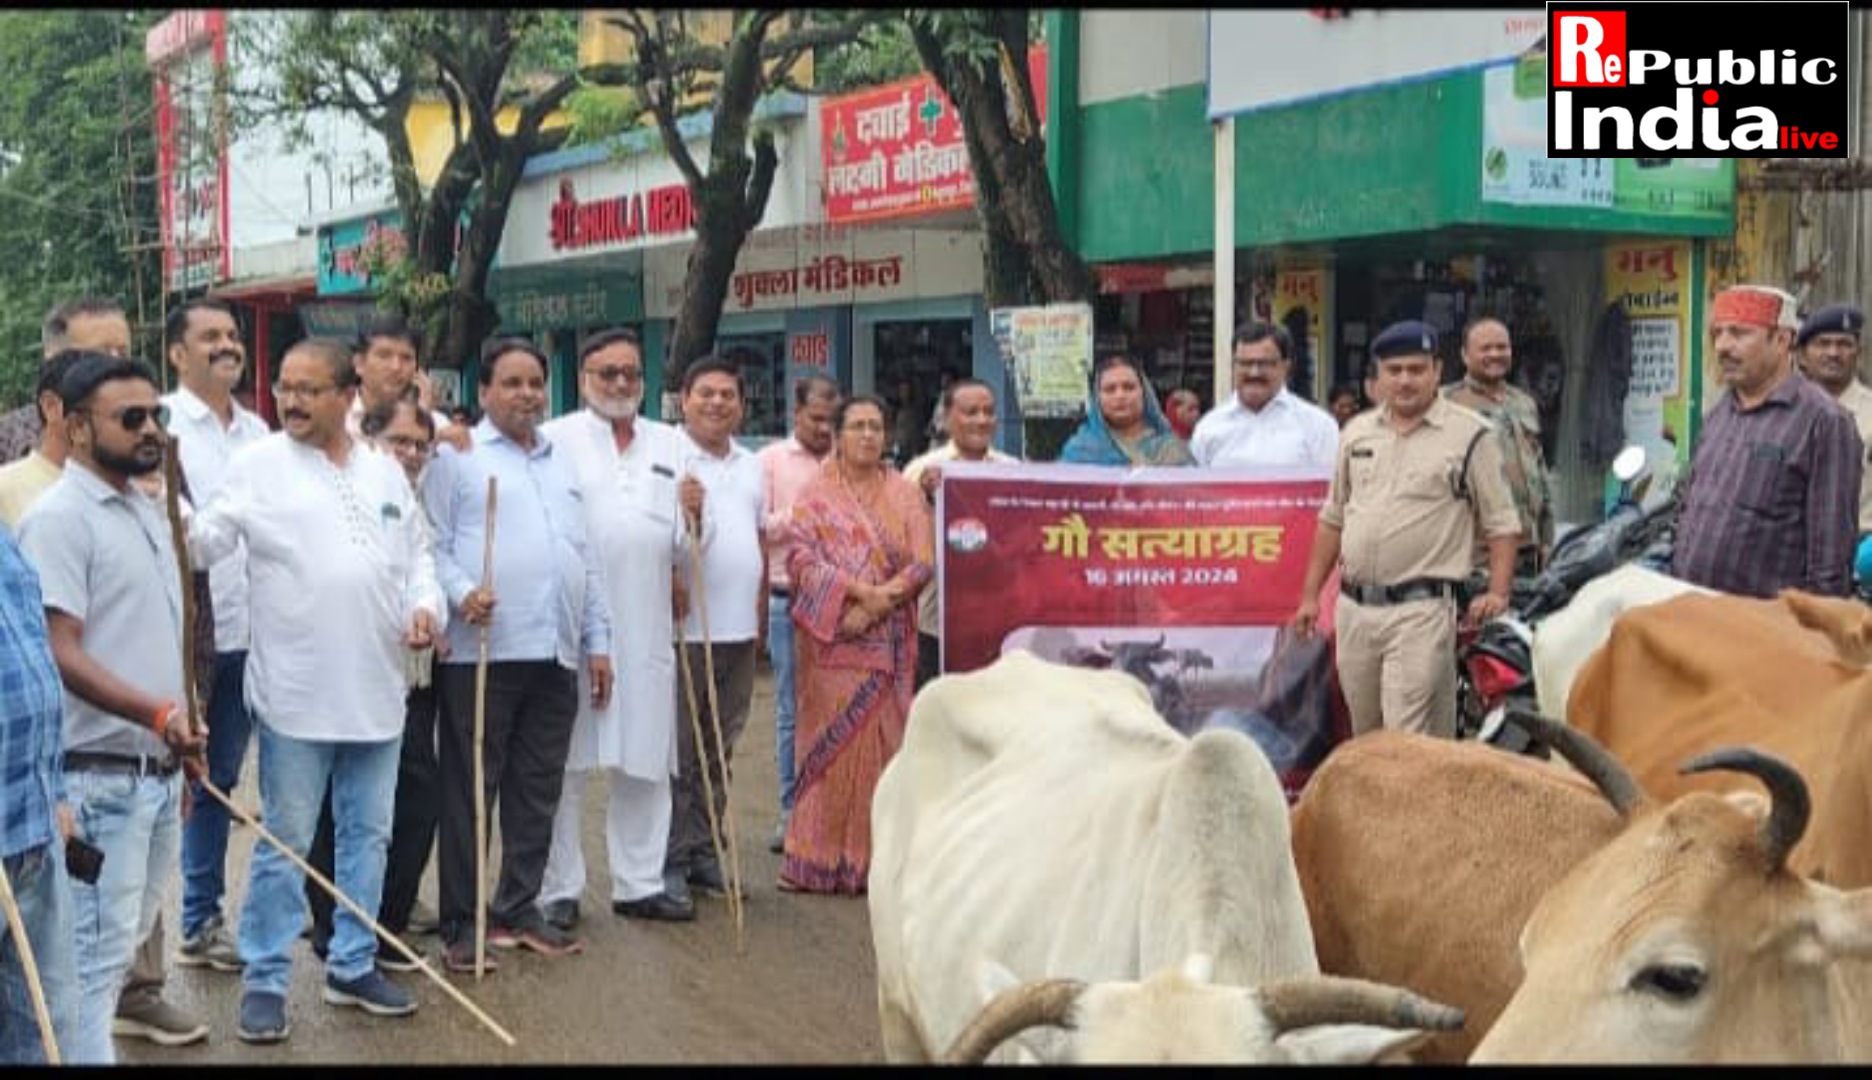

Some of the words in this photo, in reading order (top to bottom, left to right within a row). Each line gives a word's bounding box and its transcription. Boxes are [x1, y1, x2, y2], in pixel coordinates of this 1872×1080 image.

[856, 90, 911, 146] दवाई
[734, 267, 798, 308] शुक्ला
[1041, 512, 1091, 559] गौ
[1097, 524, 1284, 563] सत्याग्रह
